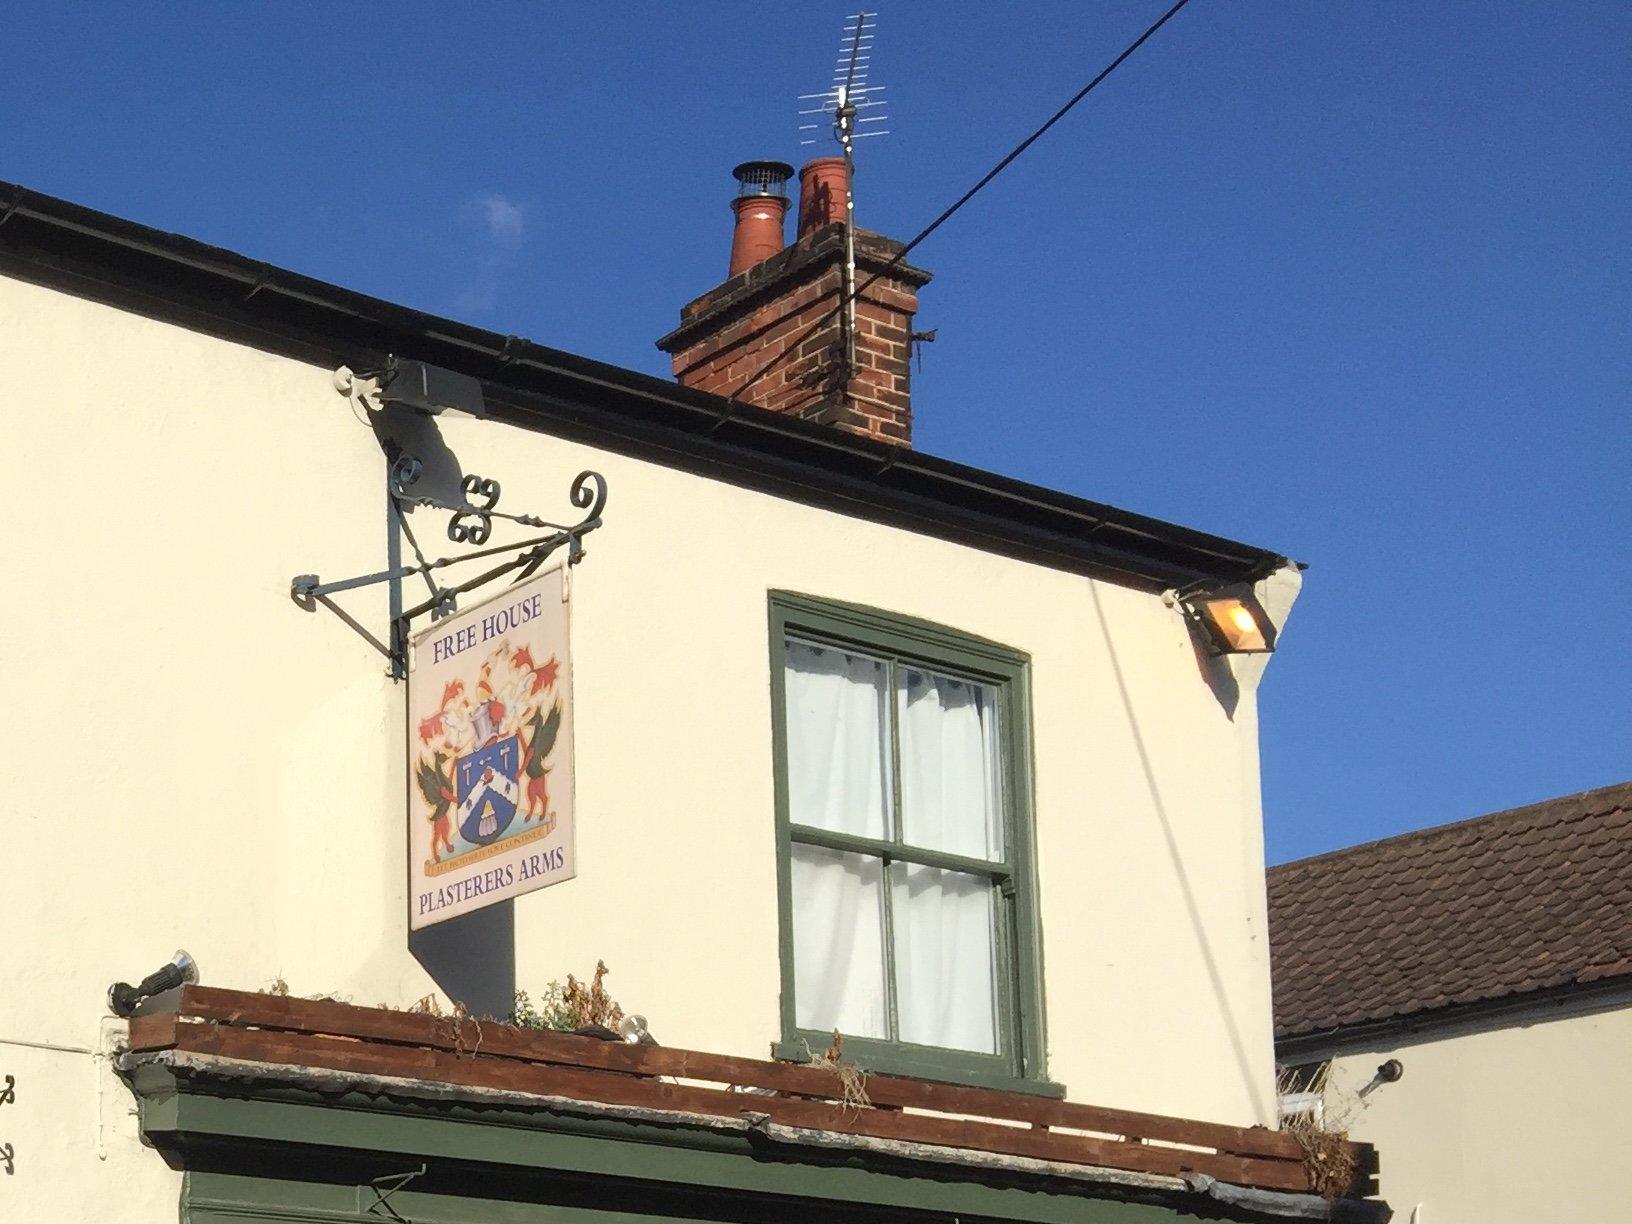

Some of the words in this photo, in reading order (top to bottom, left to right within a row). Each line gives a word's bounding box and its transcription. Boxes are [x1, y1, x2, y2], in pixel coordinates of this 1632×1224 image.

[432, 628, 477, 664] FREE
[481, 593, 543, 643] HOUSE
[419, 864, 514, 915] PLASTERERS
[518, 846, 564, 881] ARMS
